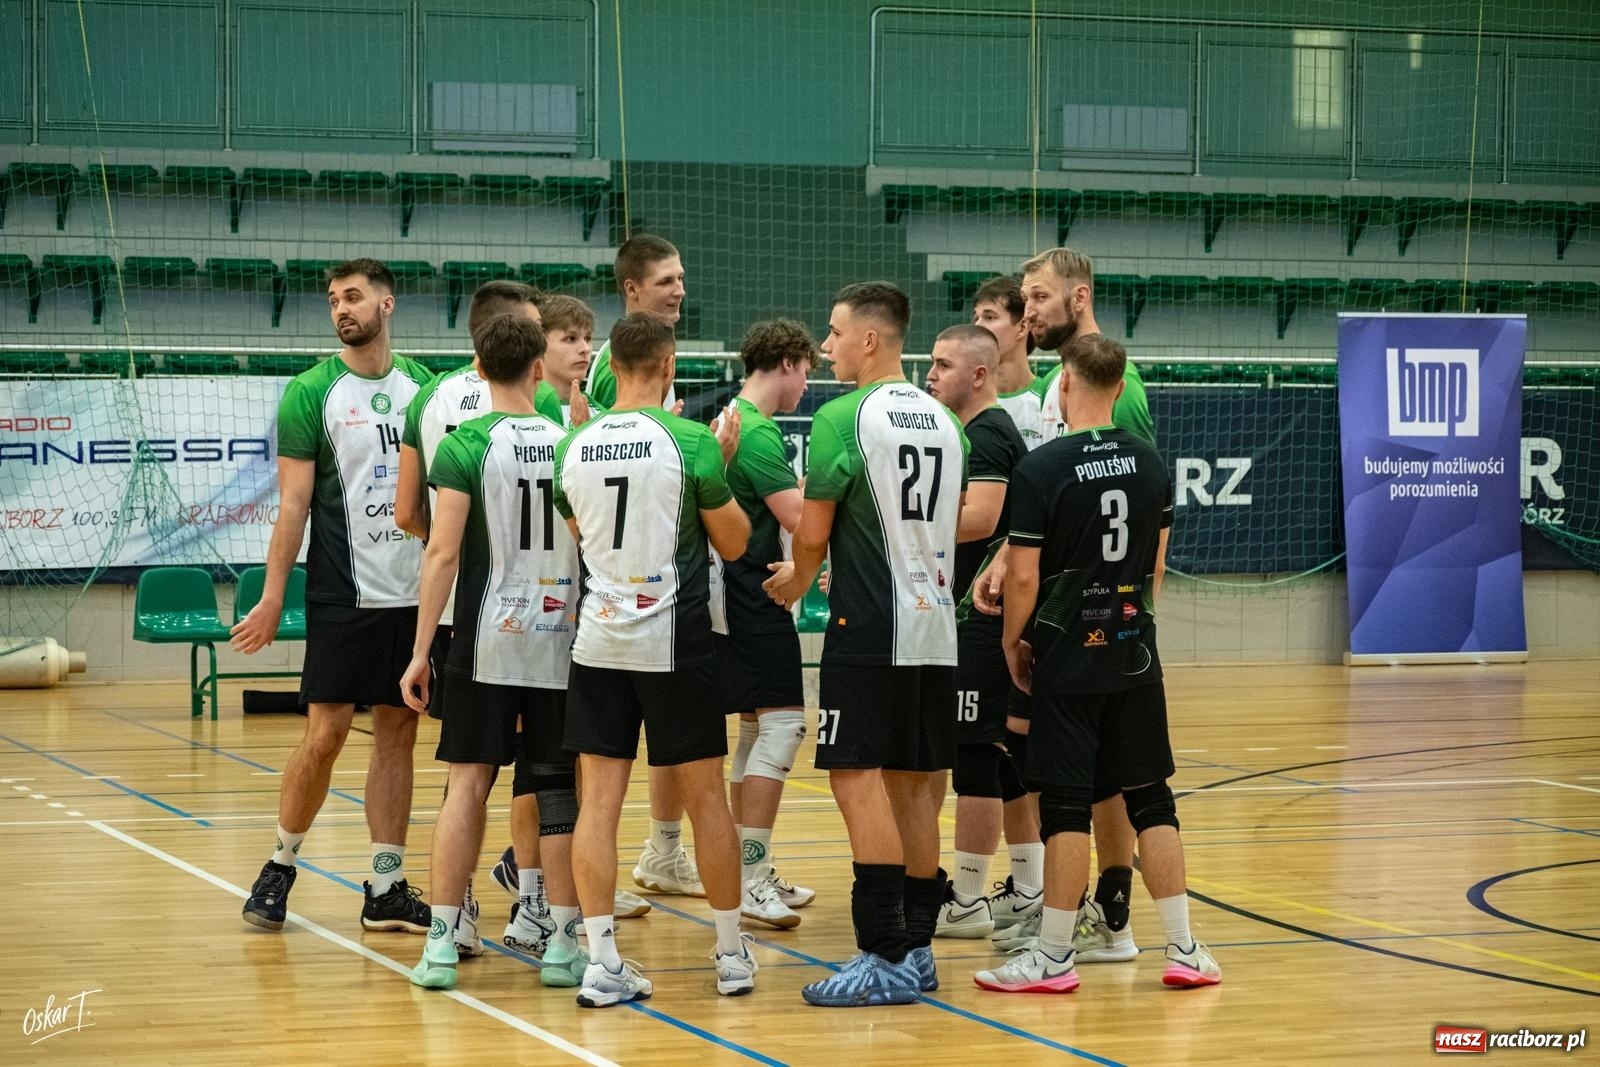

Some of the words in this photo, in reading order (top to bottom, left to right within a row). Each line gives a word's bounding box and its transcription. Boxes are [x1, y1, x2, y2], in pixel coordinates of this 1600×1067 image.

[1386, 348, 1479, 436] bmp
[886, 411, 939, 430] KUBICZEK
[376, 423, 401, 454] 14
[581, 441, 653, 462] BŁASZCZOK
[1075, 454, 1137, 482] PODLEŚNY
[1364, 456, 1429, 478] budujemy
[1433, 457, 1504, 475] możliwości
[899, 444, 943, 522] 27
[1390, 480, 1479, 500] porozumienia
[517, 478, 555, 550] 11
[604, 476, 629, 549] 7
[1100, 489, 1129, 562] 3
[1520, 502, 1565, 524] ÓRZ
[957, 690, 979, 722] 15
[816, 708, 841, 745] 27
